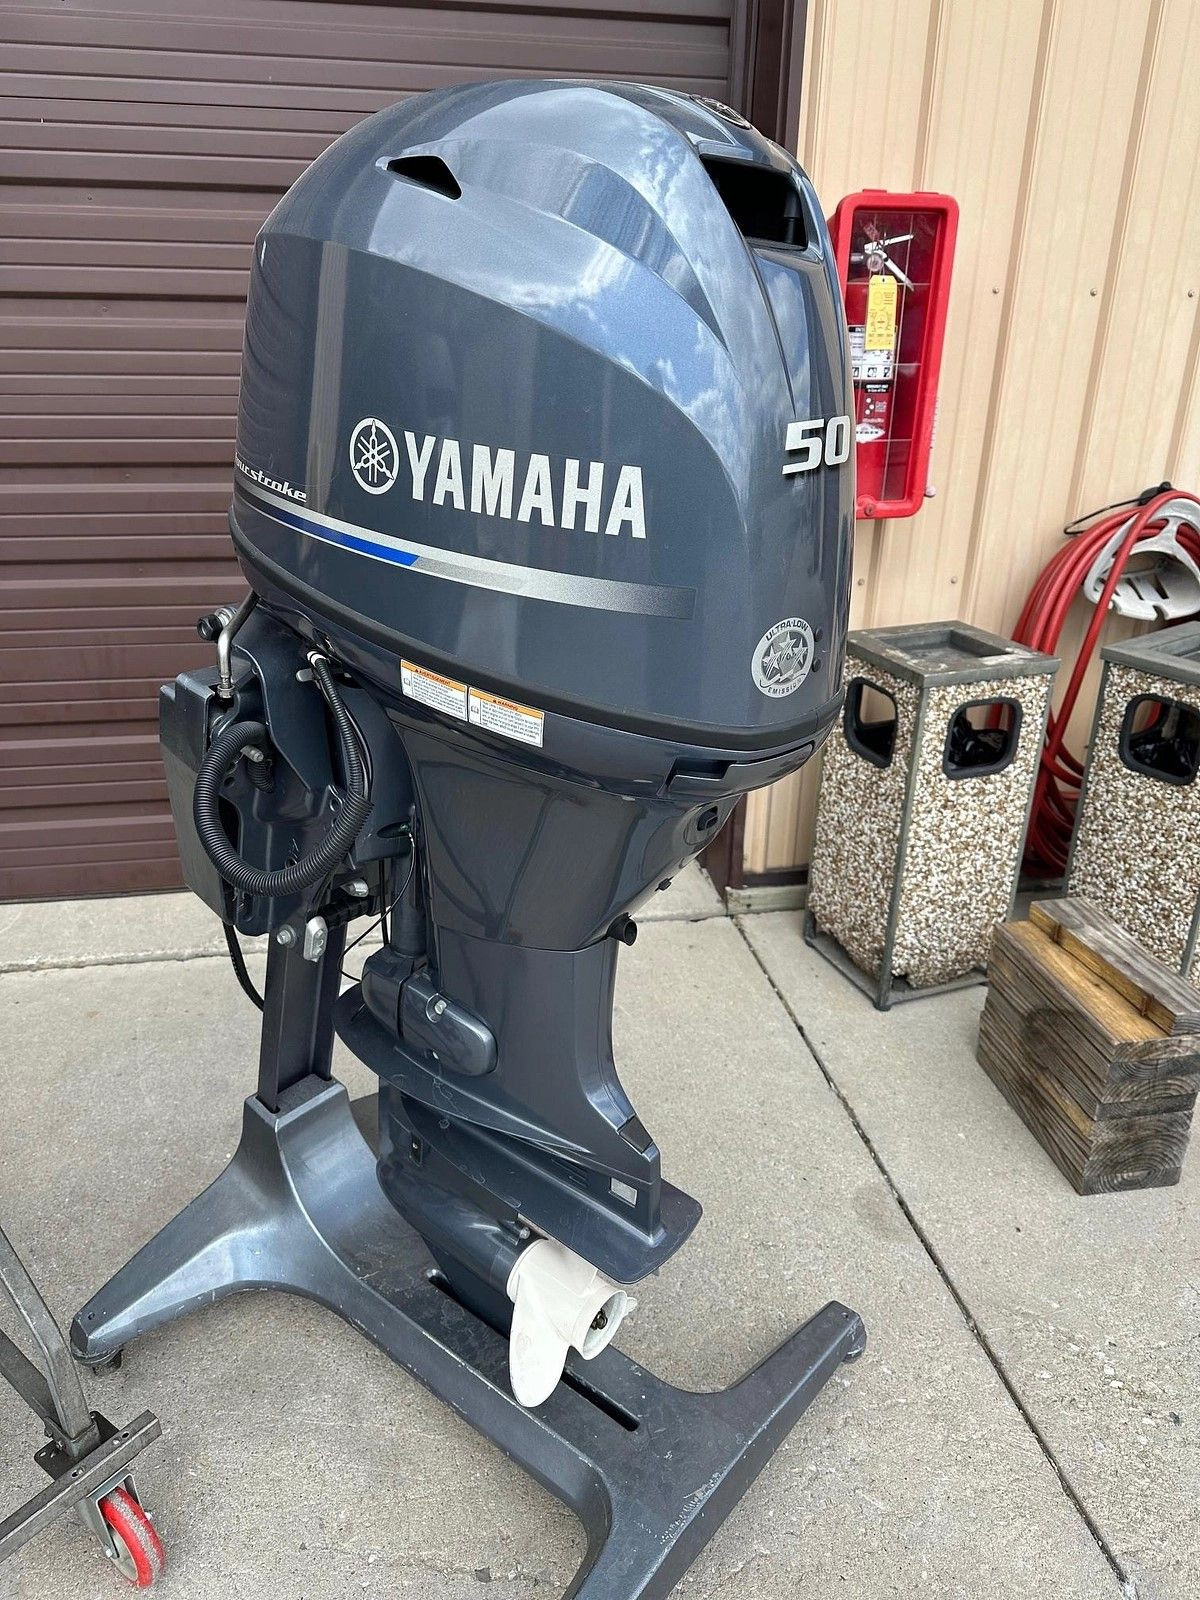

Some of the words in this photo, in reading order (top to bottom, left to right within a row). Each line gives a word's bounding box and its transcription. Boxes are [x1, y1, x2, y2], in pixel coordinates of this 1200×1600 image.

[782, 415, 850, 475] 50
[235, 452, 307, 503] ourstroke
[403, 430, 647, 540] YAMAHA
